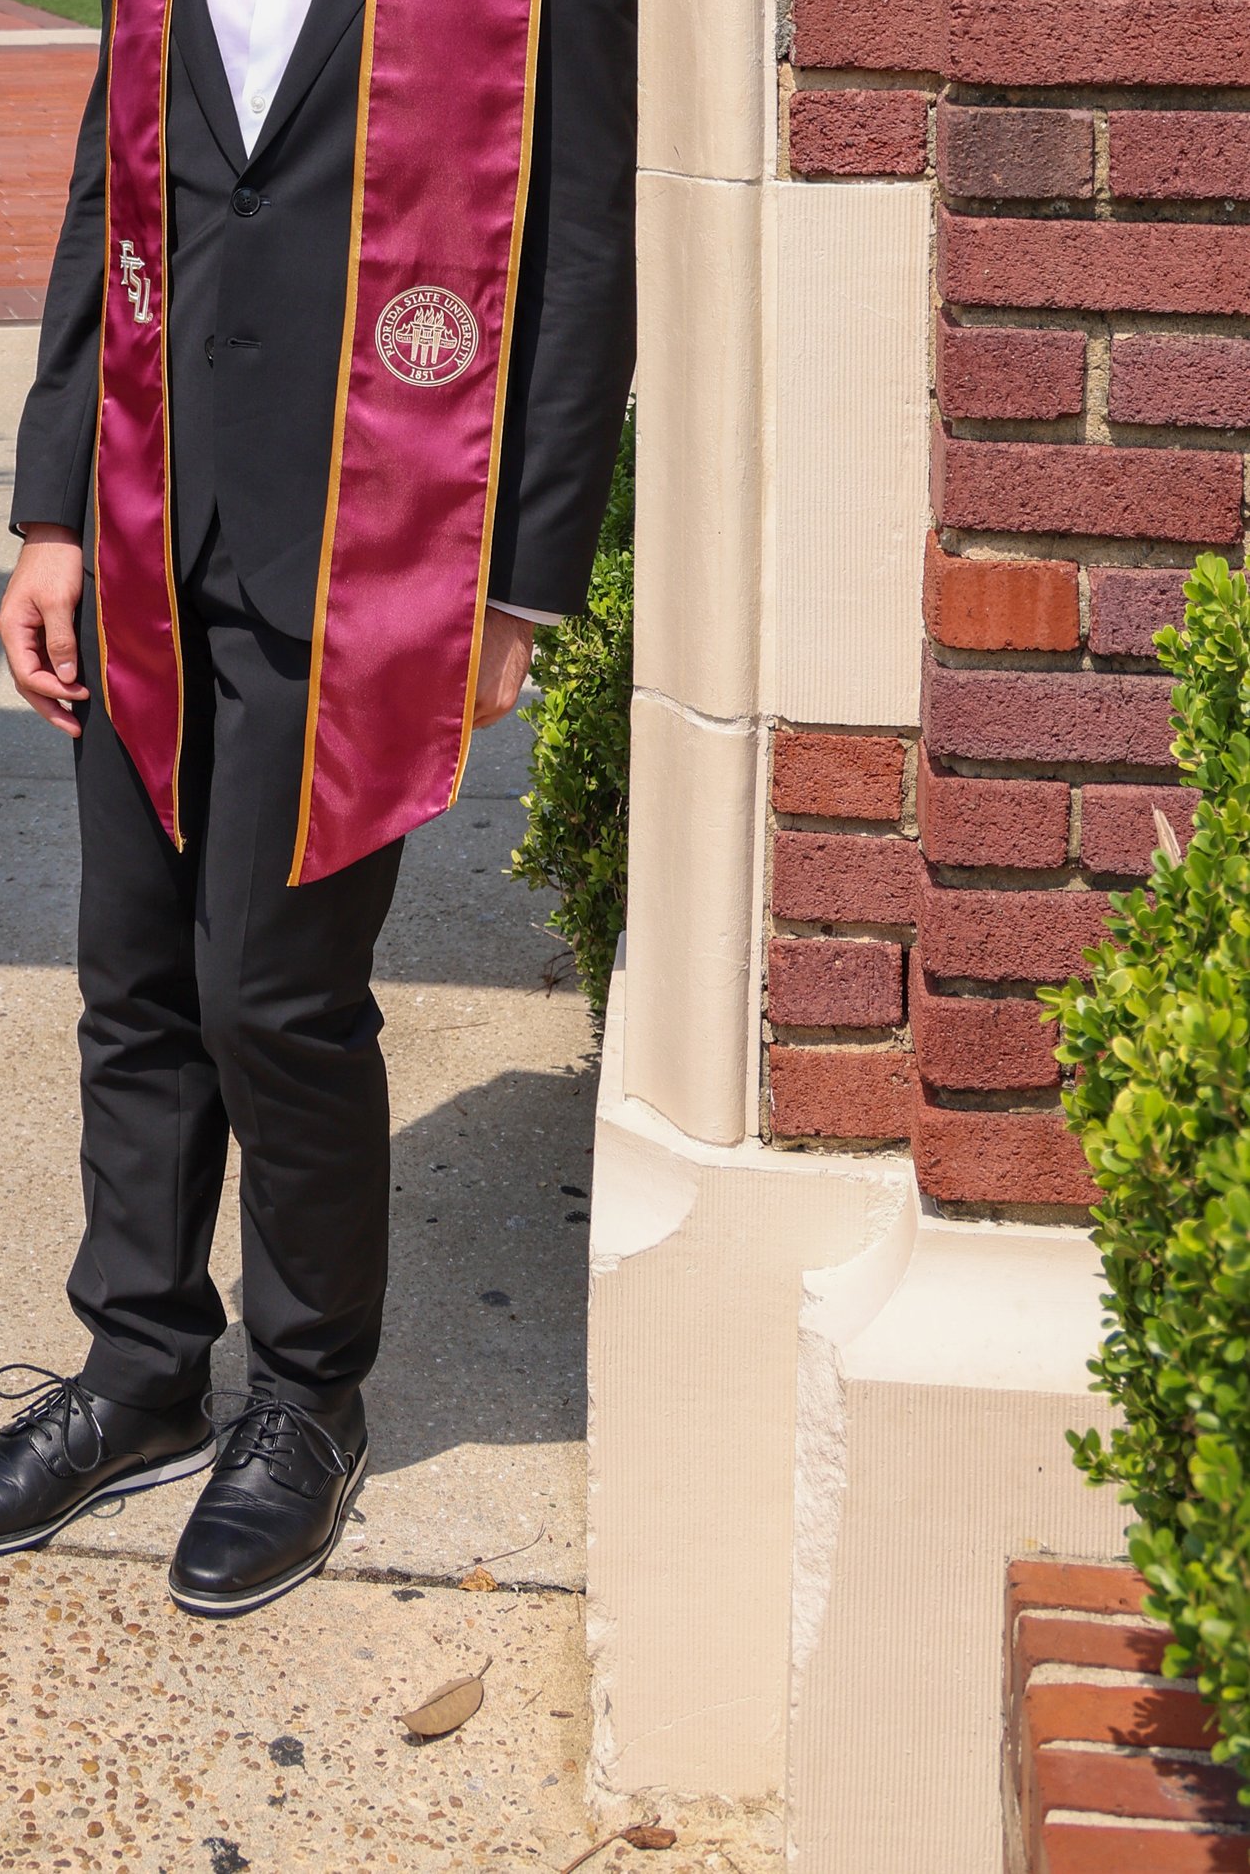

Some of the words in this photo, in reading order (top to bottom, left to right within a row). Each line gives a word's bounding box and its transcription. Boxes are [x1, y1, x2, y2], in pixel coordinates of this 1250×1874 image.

[119, 240, 151, 324] FSU
[382, 305, 404, 358] FLORIDA
[403, 292, 441, 307] STATE
[444, 298, 472, 367] UNIVERSITY
[409, 368, 435, 381] 1851
